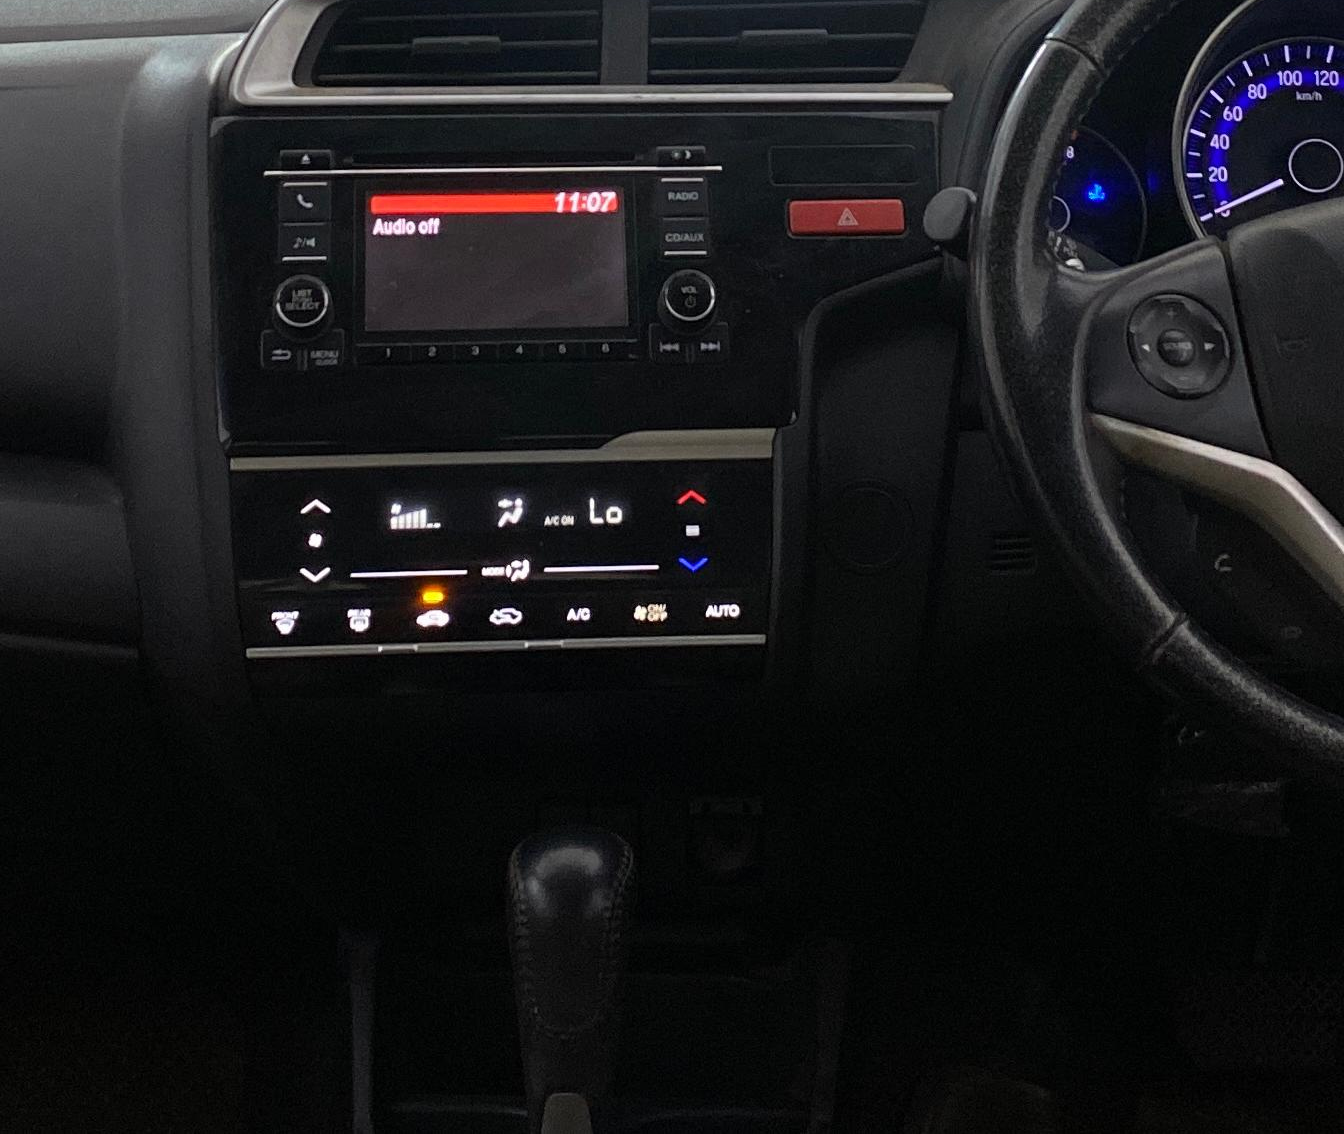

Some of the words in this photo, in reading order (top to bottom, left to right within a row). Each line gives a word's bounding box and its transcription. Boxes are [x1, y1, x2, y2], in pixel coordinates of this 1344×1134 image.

[1278, 71, 1302, 87] 100
[1314, 71, 1339, 87] 120
[1248, 85, 1267, 101] 80
[1296, 91, 1322, 102] km/h
[1223, 106, 1243, 122] 60
[1210, 135, 1230, 151] 40
[1208, 167, 1228, 183] 20
[555, 191, 618, 213] 11:07
[668, 191, 699, 201] RADIO
[372, 218, 416, 236] Audio
[418, 218, 441, 235] off
[664, 233, 705, 243] CD/AUX
[386, 347, 391, 358] 1
[427, 346, 437, 357] 2
[471, 345, 480, 356] 3
[515, 345, 524, 355] 4
[589, 497, 623, 524] Lo
[561, 515, 575, 526] ON
[567, 608, 591, 621] A/C
[705, 604, 740, 618] AUTO
